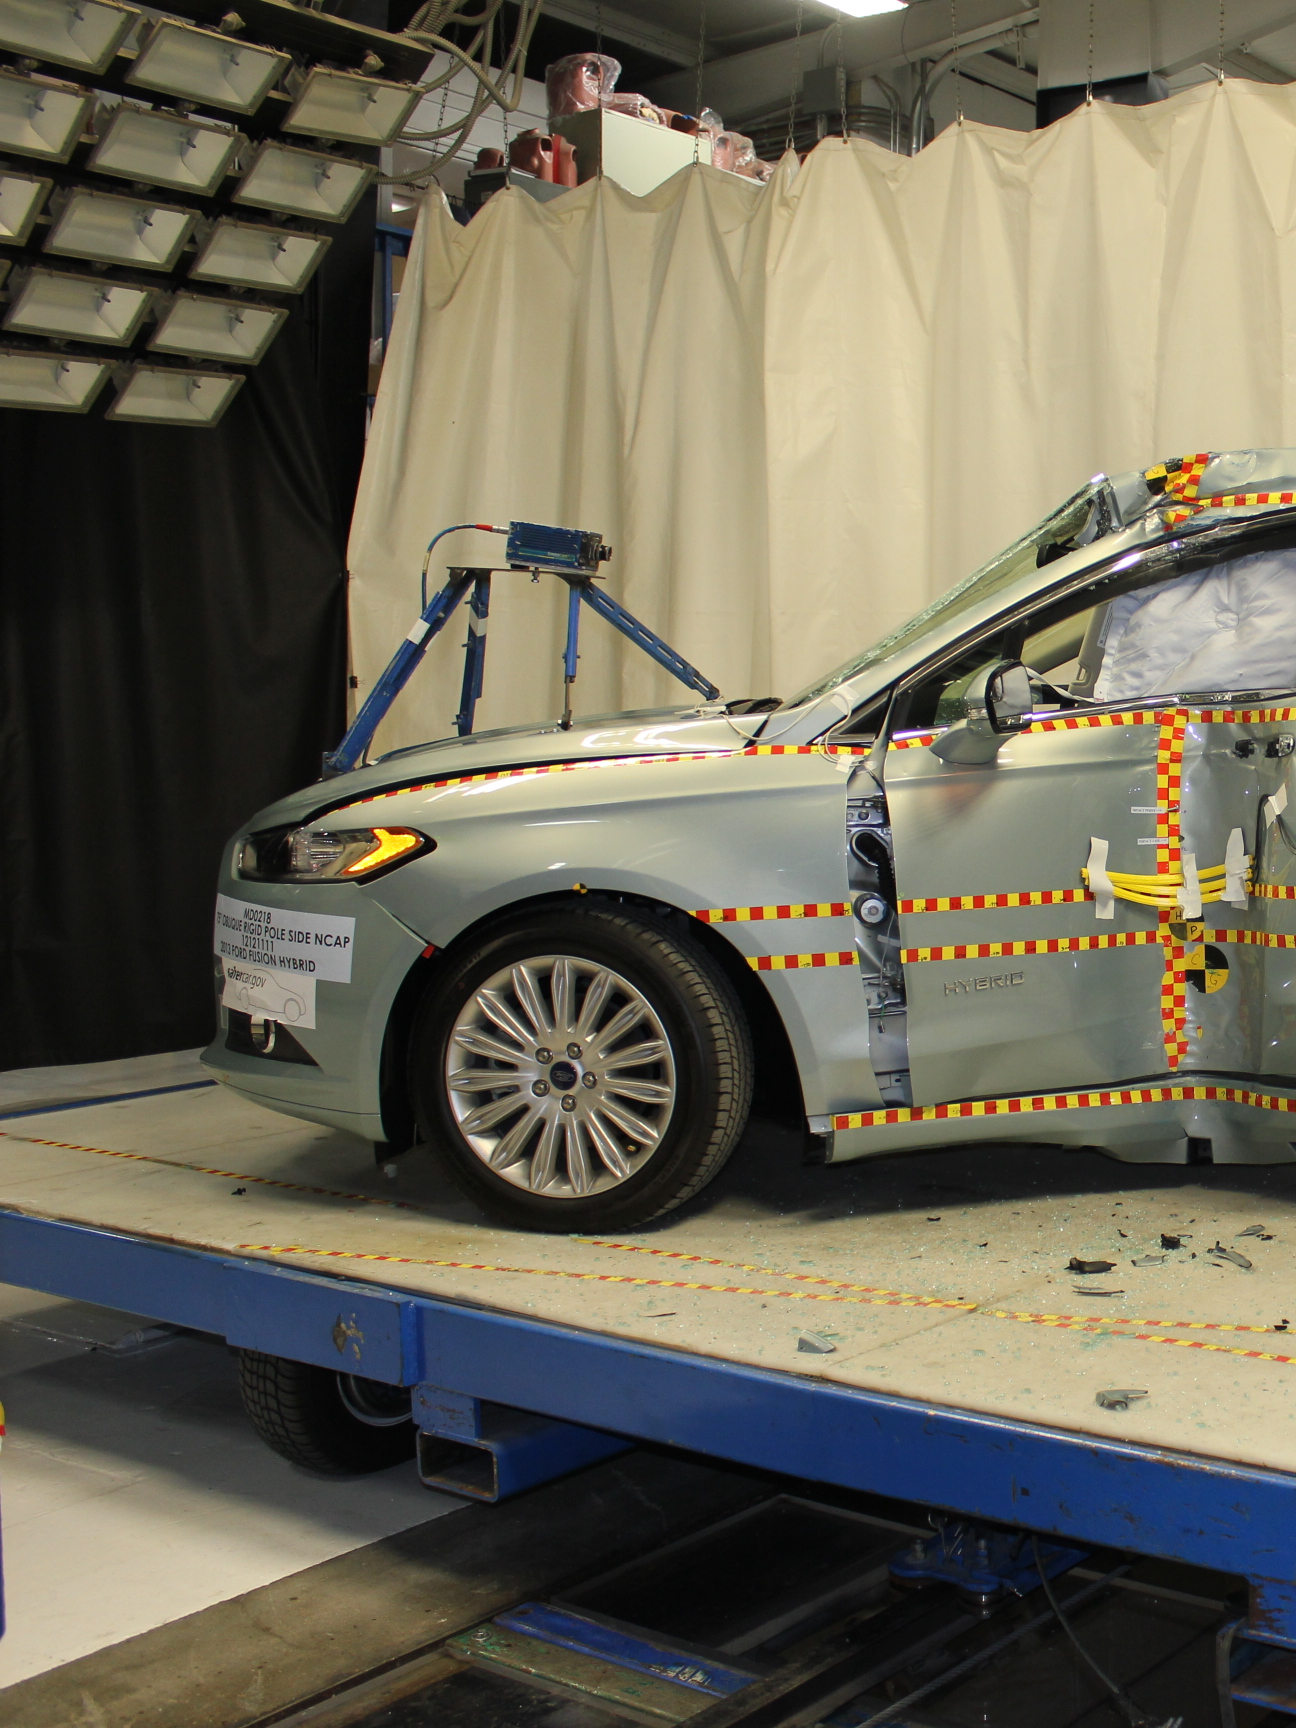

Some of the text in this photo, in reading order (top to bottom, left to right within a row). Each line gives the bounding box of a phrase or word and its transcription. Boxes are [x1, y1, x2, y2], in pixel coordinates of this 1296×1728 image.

[243, 907, 272, 924] MD0218
[1175, 910, 1182, 920] H
[222, 914, 243, 931] OBLIQUE
[243, 921, 262, 936] RIGID
[264, 926, 286, 941] POLE
[288, 930, 311, 944] SIDE
[314, 933, 350, 949] NCAP
[1190, 925, 1198, 935] P
[242, 934, 274, 952] 12121111
[220, 940, 316, 972] 2013 FORD FUSION HYBRID
[1191, 953, 1200, 965] C
[227, 966, 267, 990] safercar.gov
[944, 971, 1025, 996] HYBRID
